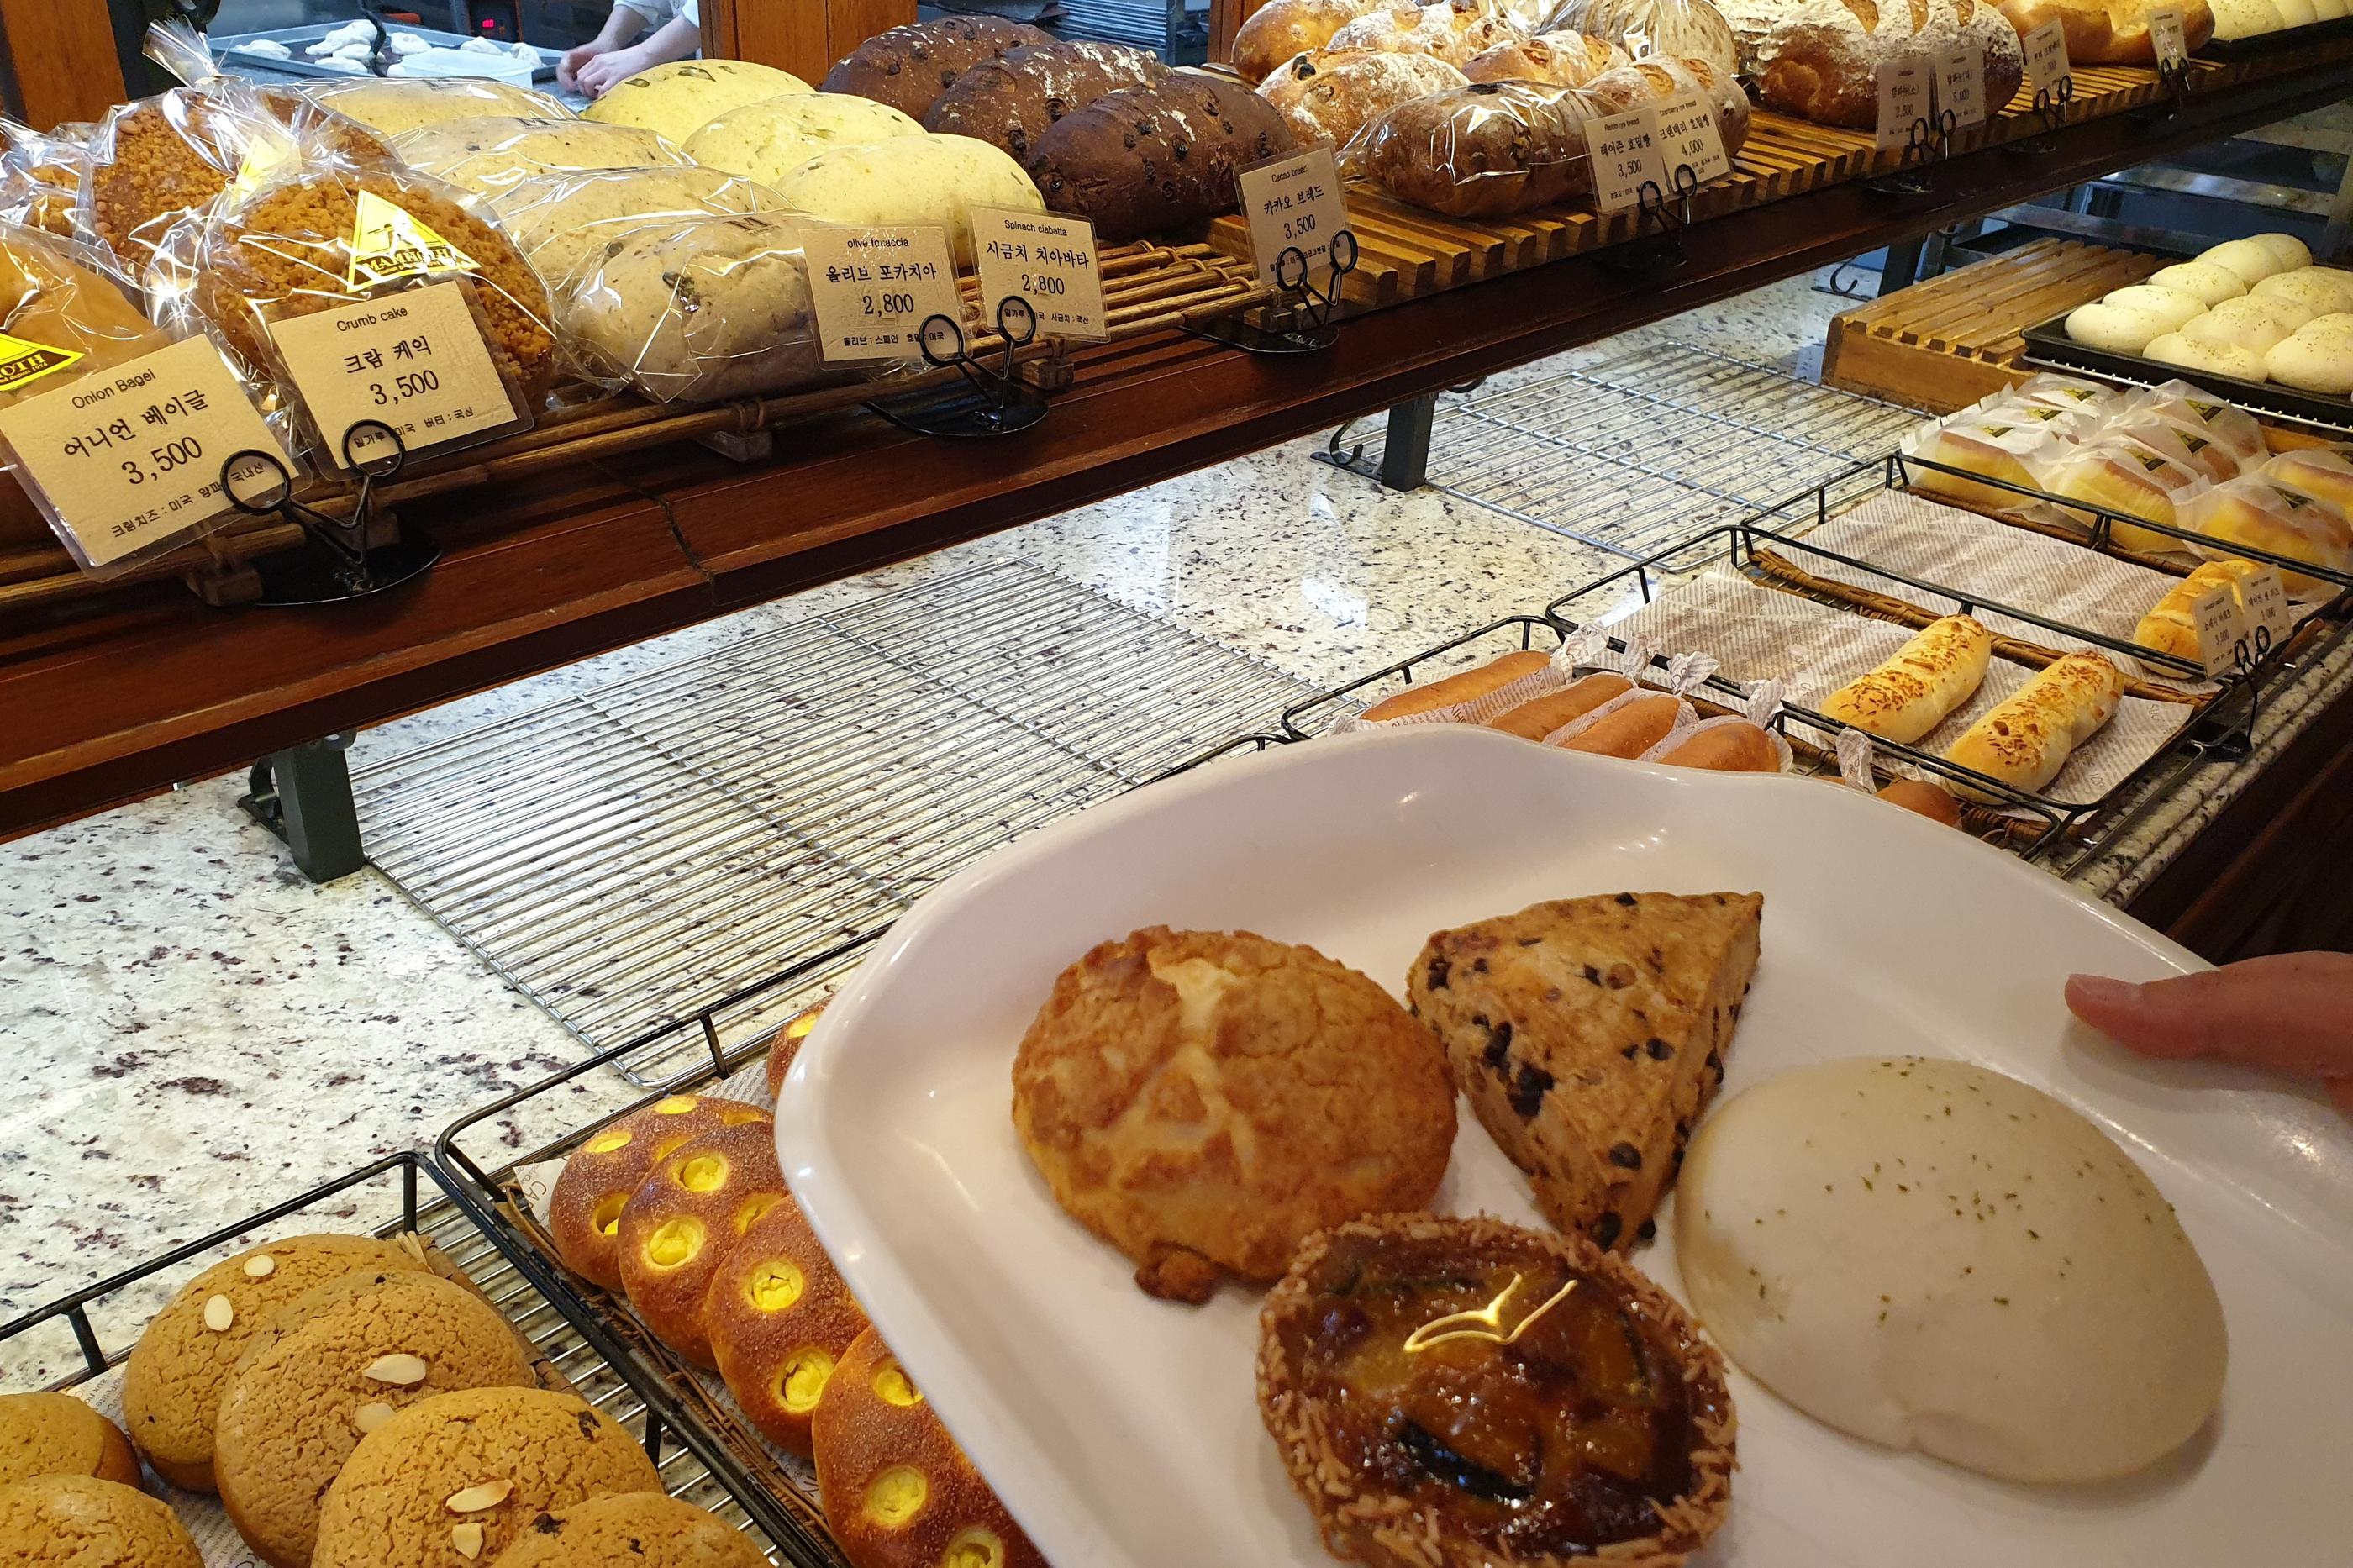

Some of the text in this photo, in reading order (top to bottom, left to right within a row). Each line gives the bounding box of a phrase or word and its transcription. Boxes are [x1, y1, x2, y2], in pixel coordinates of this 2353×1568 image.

[1682, 139, 1704, 157] 4,000
[1271, 171, 1291, 183] Cacao
[1617, 159, 1642, 178] 3,500
[1263, 196, 1293, 216] 카카오
[1004, 220, 1068, 237] Spinach ciabatta
[1284, 214, 1316, 240] 3,500
[847, 238, 868, 249] olive
[986, 240, 1090, 270] 시금치 치아바타
[826, 262, 937, 284] 올리브 포카치아
[1021, 273, 1065, 297] 2,800
[862, 294, 914, 318] 2,800
[336, 307, 408, 332] Crumb cake
[0, 353, 45, 377] OTH
[344, 336, 432, 374] 크람 케익
[71, 368, 156, 409] Onion Bagel
[369, 370, 440, 405] 3,500
[64, 390, 209, 458] 어니언 베이글
[353, 431, 386, 448] 밀가루
[453, 406, 474, 419] 국산
[121, 436, 203, 485] 3,500
[110, 509, 161, 538] 크림치즈
[169, 494, 194, 512] 미국
[230, 463, 265, 482] 국내산
